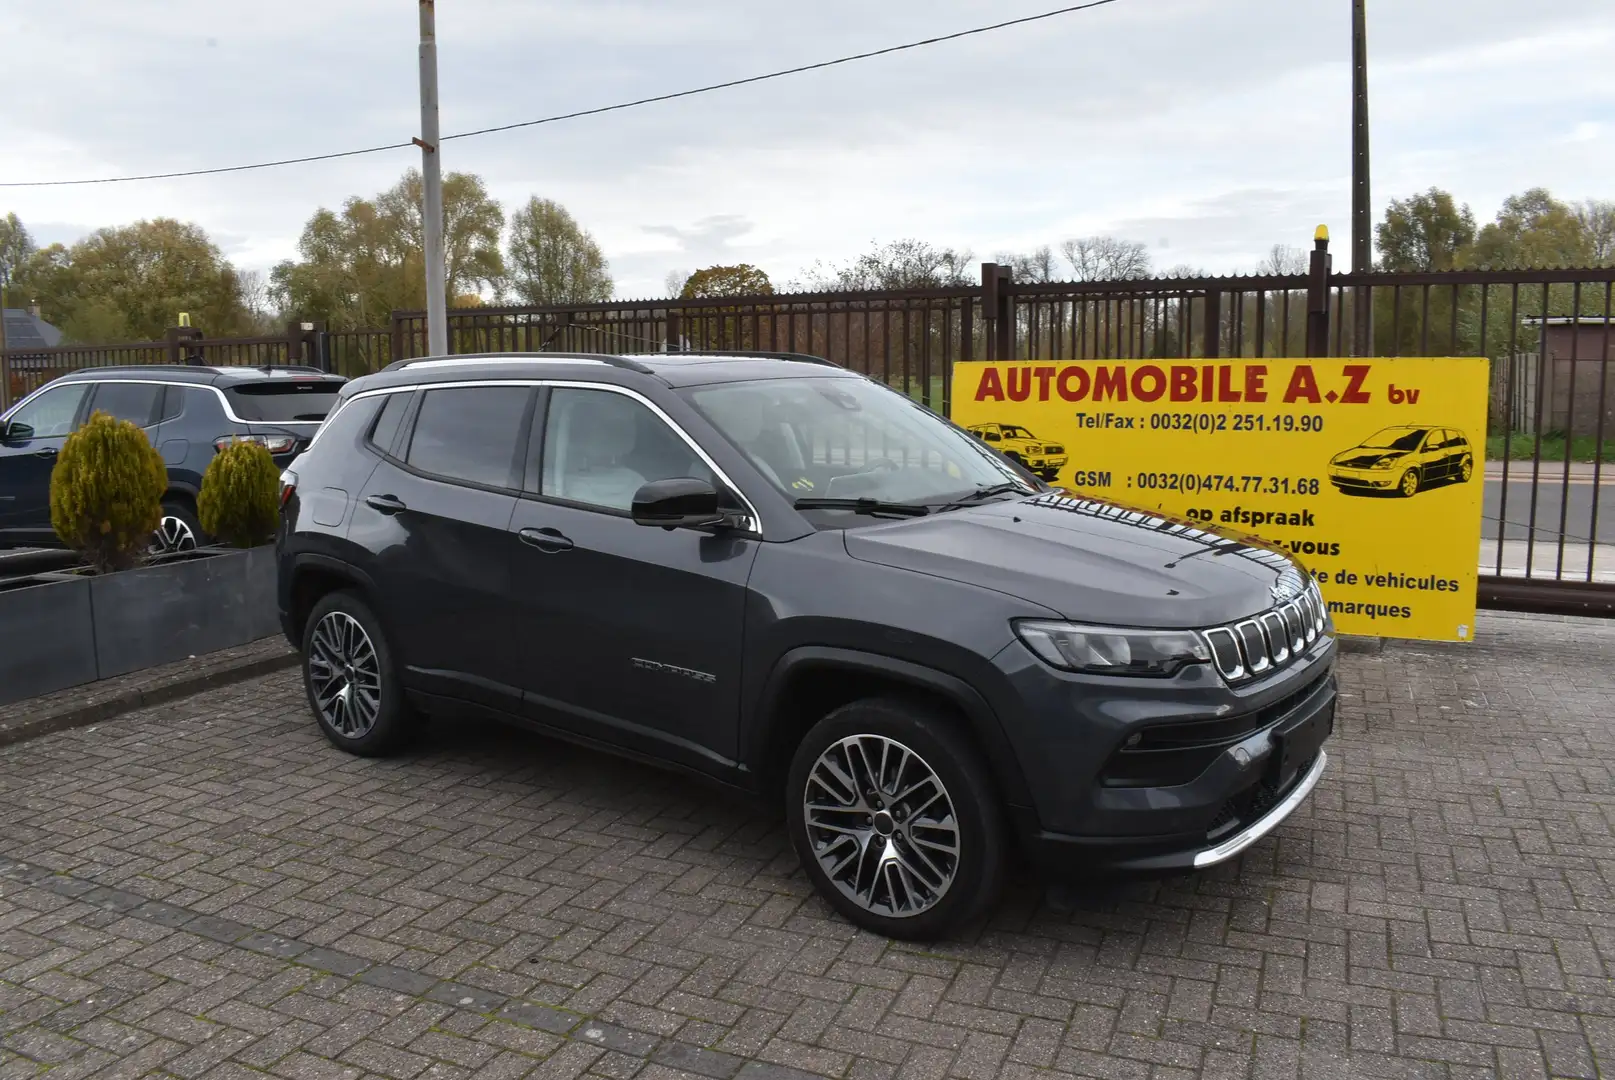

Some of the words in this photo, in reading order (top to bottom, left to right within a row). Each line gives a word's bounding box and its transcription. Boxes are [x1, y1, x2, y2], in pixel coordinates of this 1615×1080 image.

[974, 364, 1268, 402] AUTOMOBILE
[1282, 364, 1372, 404] A.Z
[1387, 383, 1421, 405] bv
[1075, 412, 1135, 429] Tel/Fax
[1150, 412, 1227, 434] 0032(0)2
[1232, 413, 1324, 432] 251.19.90
[1074, 470, 1112, 488] GSM
[1137, 472, 1320, 496] 0032(0)474.77.31.68
[1220, 506, 1315, 528] afspraak
[1335, 569, 1358, 585] de
[1364, 571, 1460, 593] vehicules
[1327, 599, 1412, 620] marques
